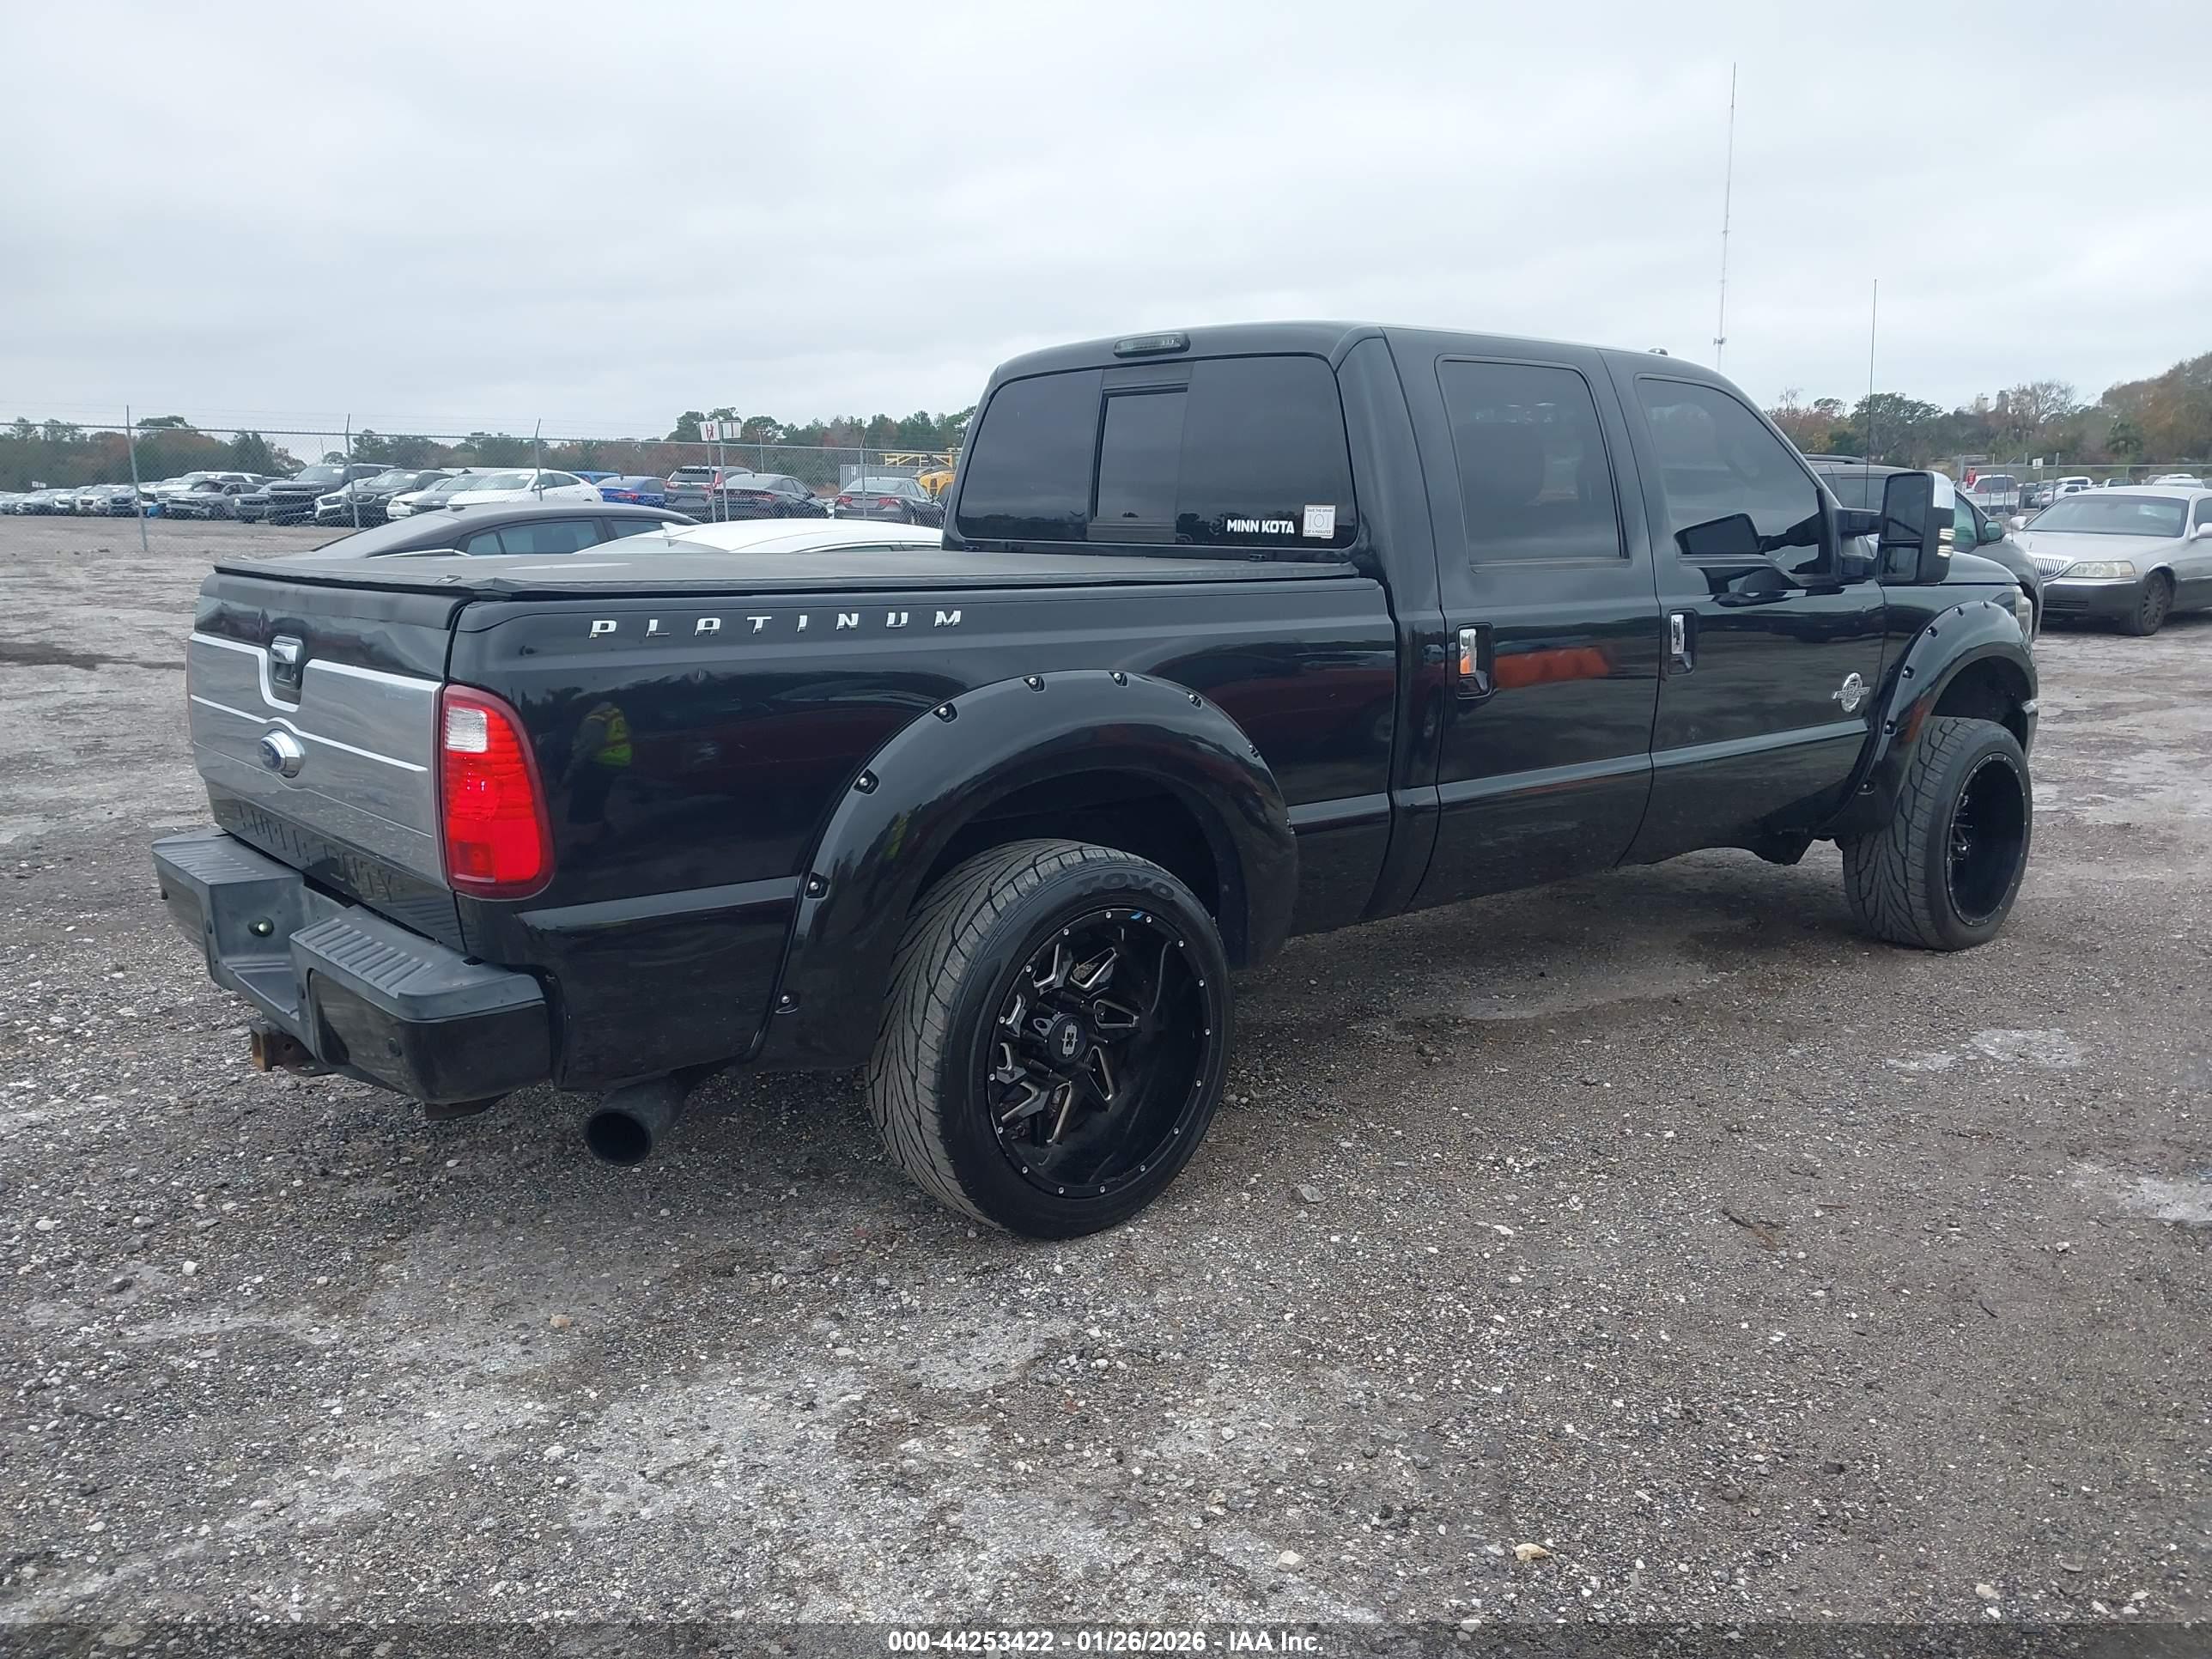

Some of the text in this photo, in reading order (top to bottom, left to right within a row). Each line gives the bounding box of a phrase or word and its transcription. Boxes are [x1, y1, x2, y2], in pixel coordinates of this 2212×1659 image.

[1226, 519, 1295, 534] MINN KOTA
[588, 610, 962, 640] PLATINUM
[1073, 872, 1176, 901] TOYO
